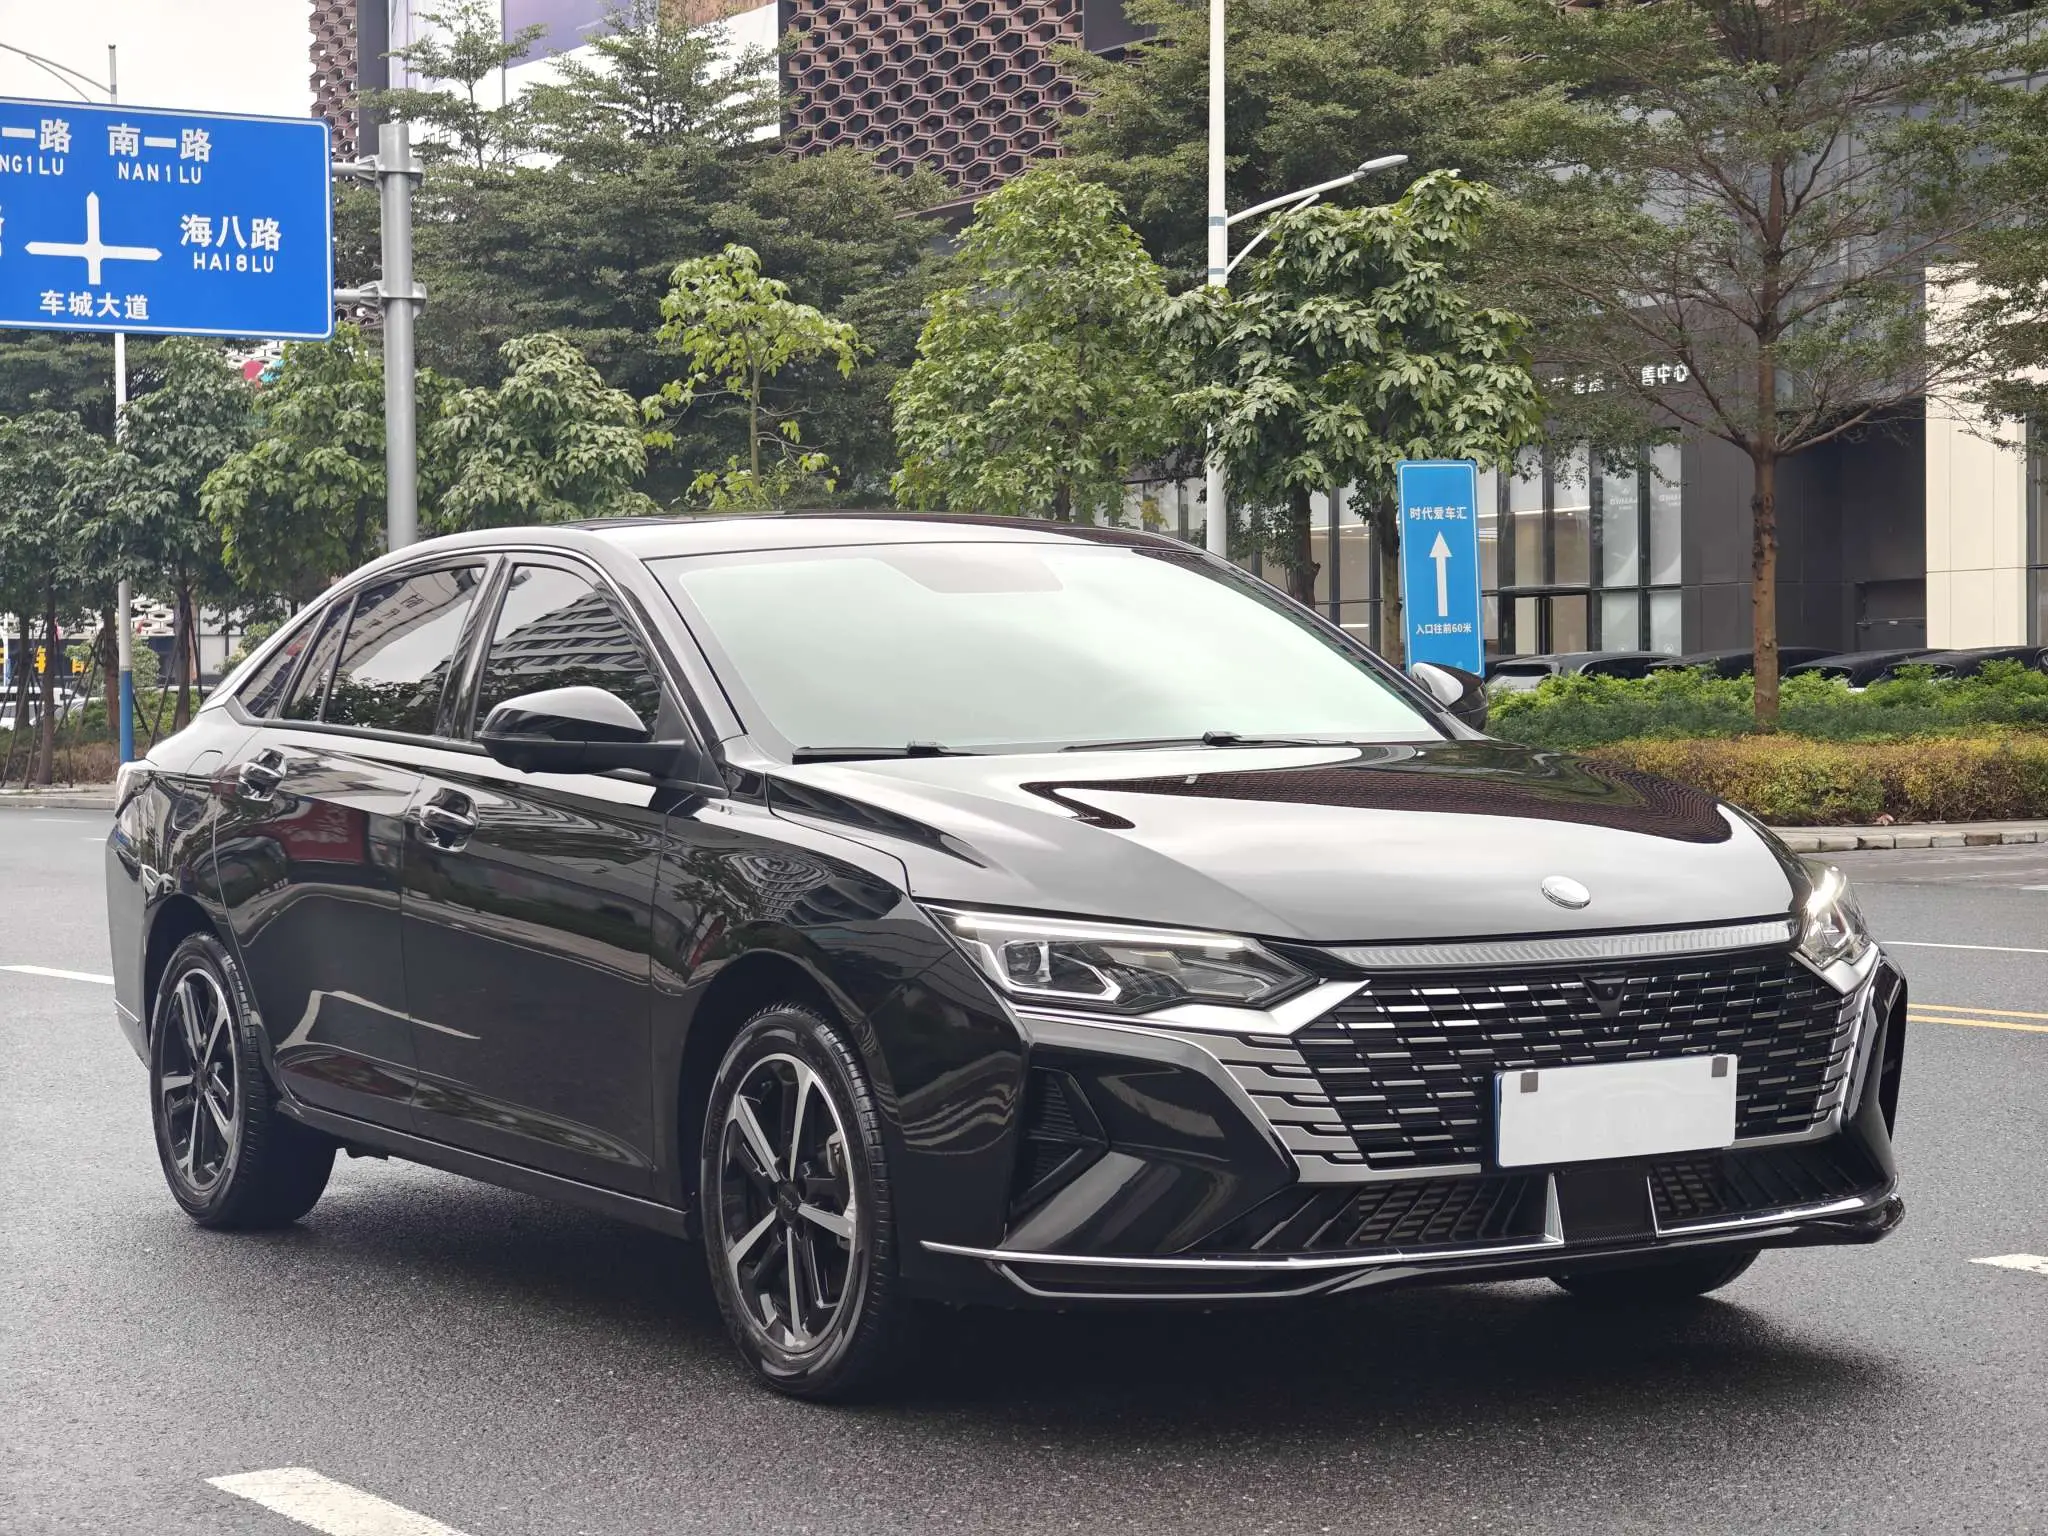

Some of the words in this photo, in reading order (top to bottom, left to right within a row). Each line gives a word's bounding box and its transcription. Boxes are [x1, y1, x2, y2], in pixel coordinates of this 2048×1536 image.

[2, 118, 72, 153] 一路
[107, 123, 212, 162] 南一路
[180, 214, 281, 251] 海八路
[193, 252, 274, 273] HAI8LU
[39, 289, 149, 320] 车城大道
[1409, 506, 1468, 520] 时代爱车汇
[1415, 623, 1472, 635] 入口往前60米
